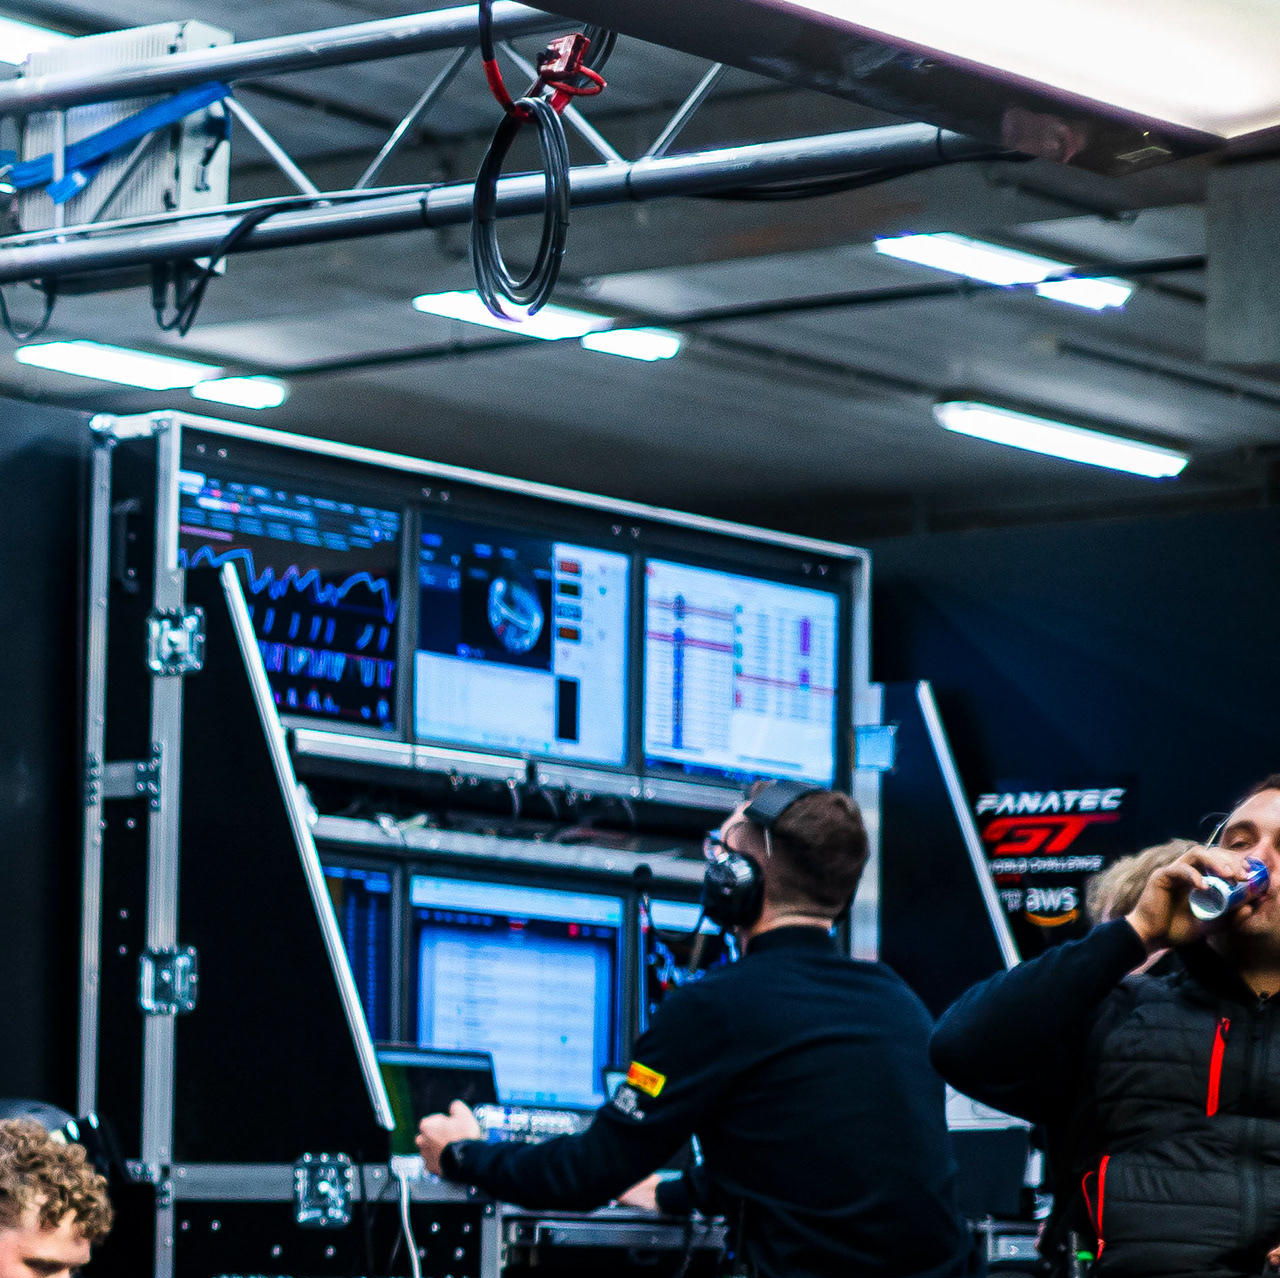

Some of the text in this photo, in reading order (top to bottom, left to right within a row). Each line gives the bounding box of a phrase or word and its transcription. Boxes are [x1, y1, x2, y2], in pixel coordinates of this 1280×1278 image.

[975, 787, 1127, 816] FANATEC
[981, 812, 1121, 858] GT
[1025, 886, 1079, 912] aws
